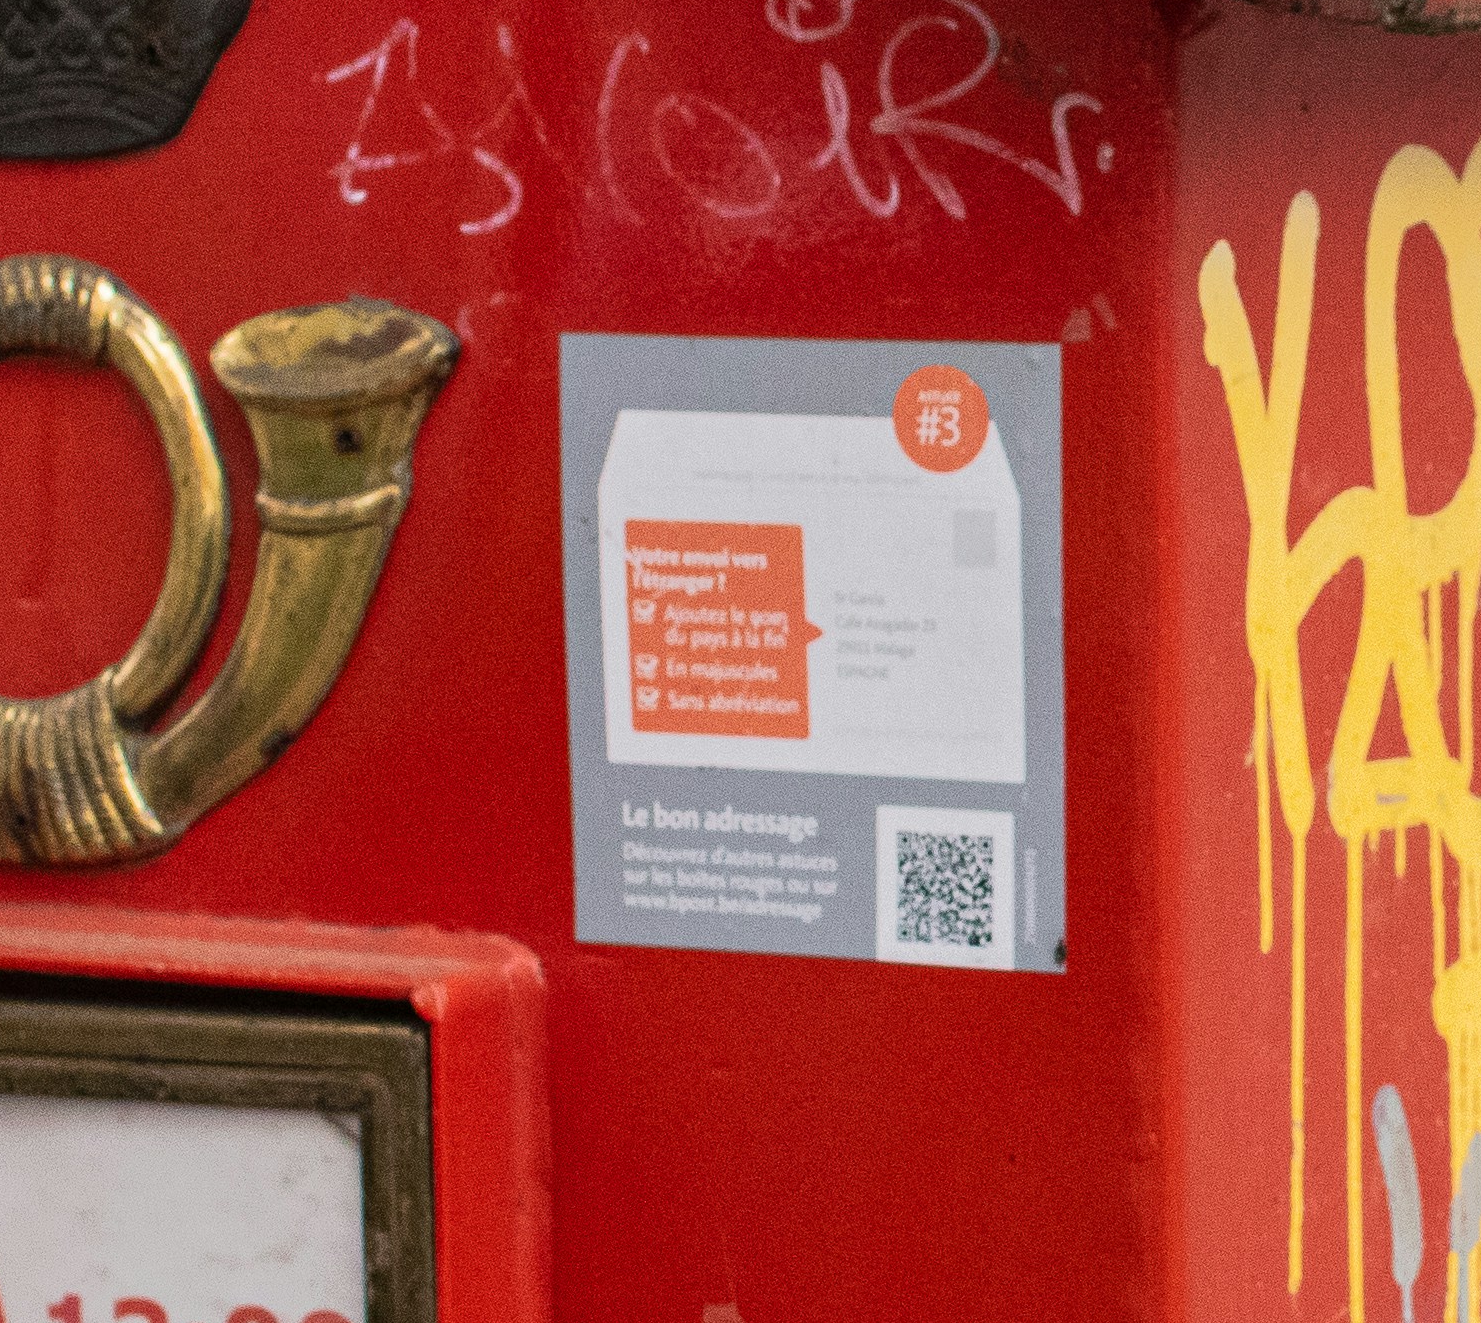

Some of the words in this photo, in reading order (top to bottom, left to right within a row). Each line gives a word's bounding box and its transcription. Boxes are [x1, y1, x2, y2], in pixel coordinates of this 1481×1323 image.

[915, 405, 961, 448] #3
[682, 547, 730, 568] envoi
[731, 552, 767, 570] vers
[689, 660, 779, 685] majuscules
[668, 689, 705, 711] Sans
[621, 799, 650, 828] Le
[652, 799, 700, 830] bon
[702, 803, 819, 845] adressage
